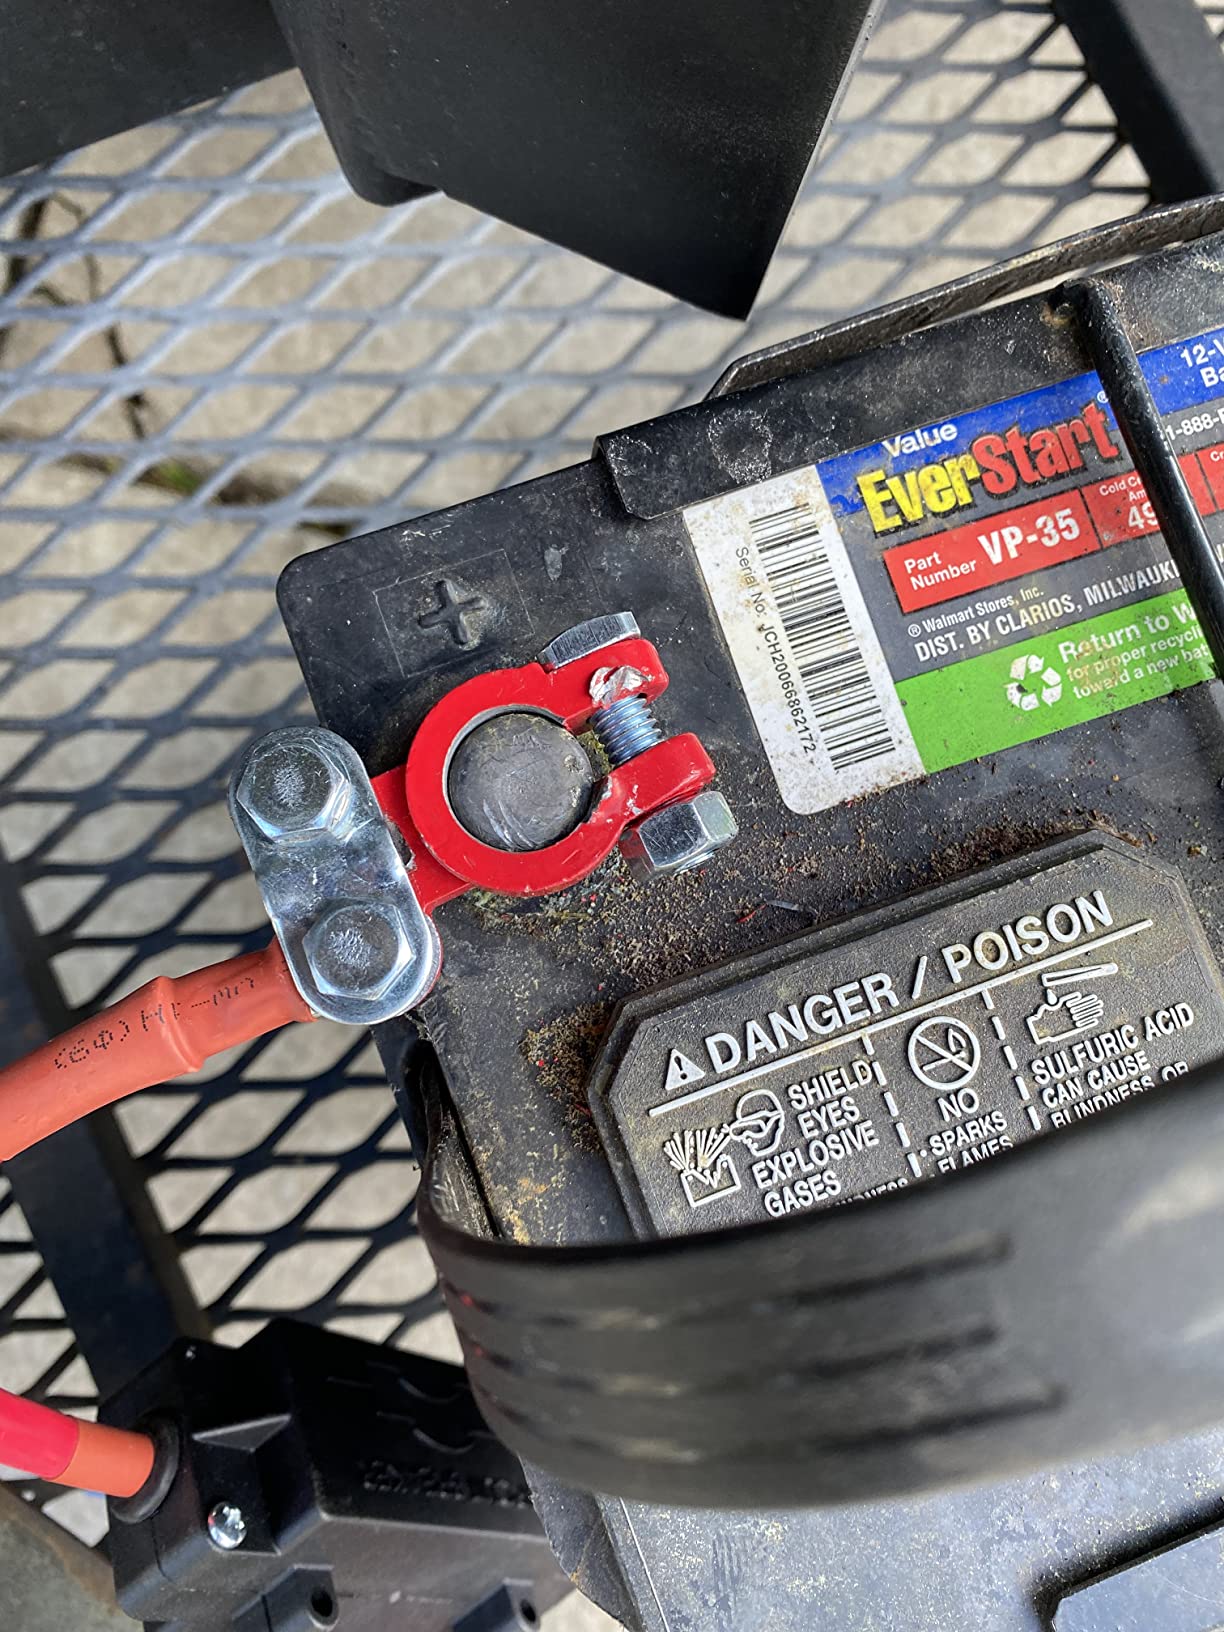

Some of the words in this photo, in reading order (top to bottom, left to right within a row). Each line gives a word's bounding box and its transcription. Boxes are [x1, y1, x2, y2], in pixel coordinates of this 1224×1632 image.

[882, 423, 958, 458] Value
[857, 401, 1118, 534] EverStart
[1099, 480, 1127, 496] Cold
[978, 508, 1081, 566] VP-35
[904, 550, 942, 575] Part
[910, 559, 977, 590] Number
[914, 631, 964, 662] DIST.
[966, 620, 991, 645] BY
[995, 593, 1083, 636] CLARIOS,
[922, 606, 976, 633] Walmart
[976, 594, 1019, 615] Stores,
[1020, 585, 1044, 601] Inc.
[735, 546, 760, 590] Serial
[759, 623, 817, 753] JCH20066862172
[1058, 623, 1142, 664] Return
[1144, 614, 1170, 634] to
[1066, 664, 1090, 682] for
[1094, 645, 1147, 675] proper
[1073, 669, 1131, 699] toward
[1133, 669, 1145, 683] a
[1146, 655, 1179, 674] new
[705, 971, 899, 1074] DANGER
[941, 889, 1114, 984] POISON
[1030, 1023, 1139, 1085] SULFURIC
[1145, 1001, 1195, 1042] ACID
[787, 1058, 873, 1111] SHIELD
[1042, 1077, 1085, 1109] CAN
[1087, 1050, 1151, 1091] CAUSE
[798, 1095, 861, 1141] EYES
[938, 1087, 980, 1122] NO
[751, 1120, 880, 1190] EXPLOSIVE
[930, 1110, 1008, 1157] SPARKS
[764, 1170, 842, 1218] GASES
